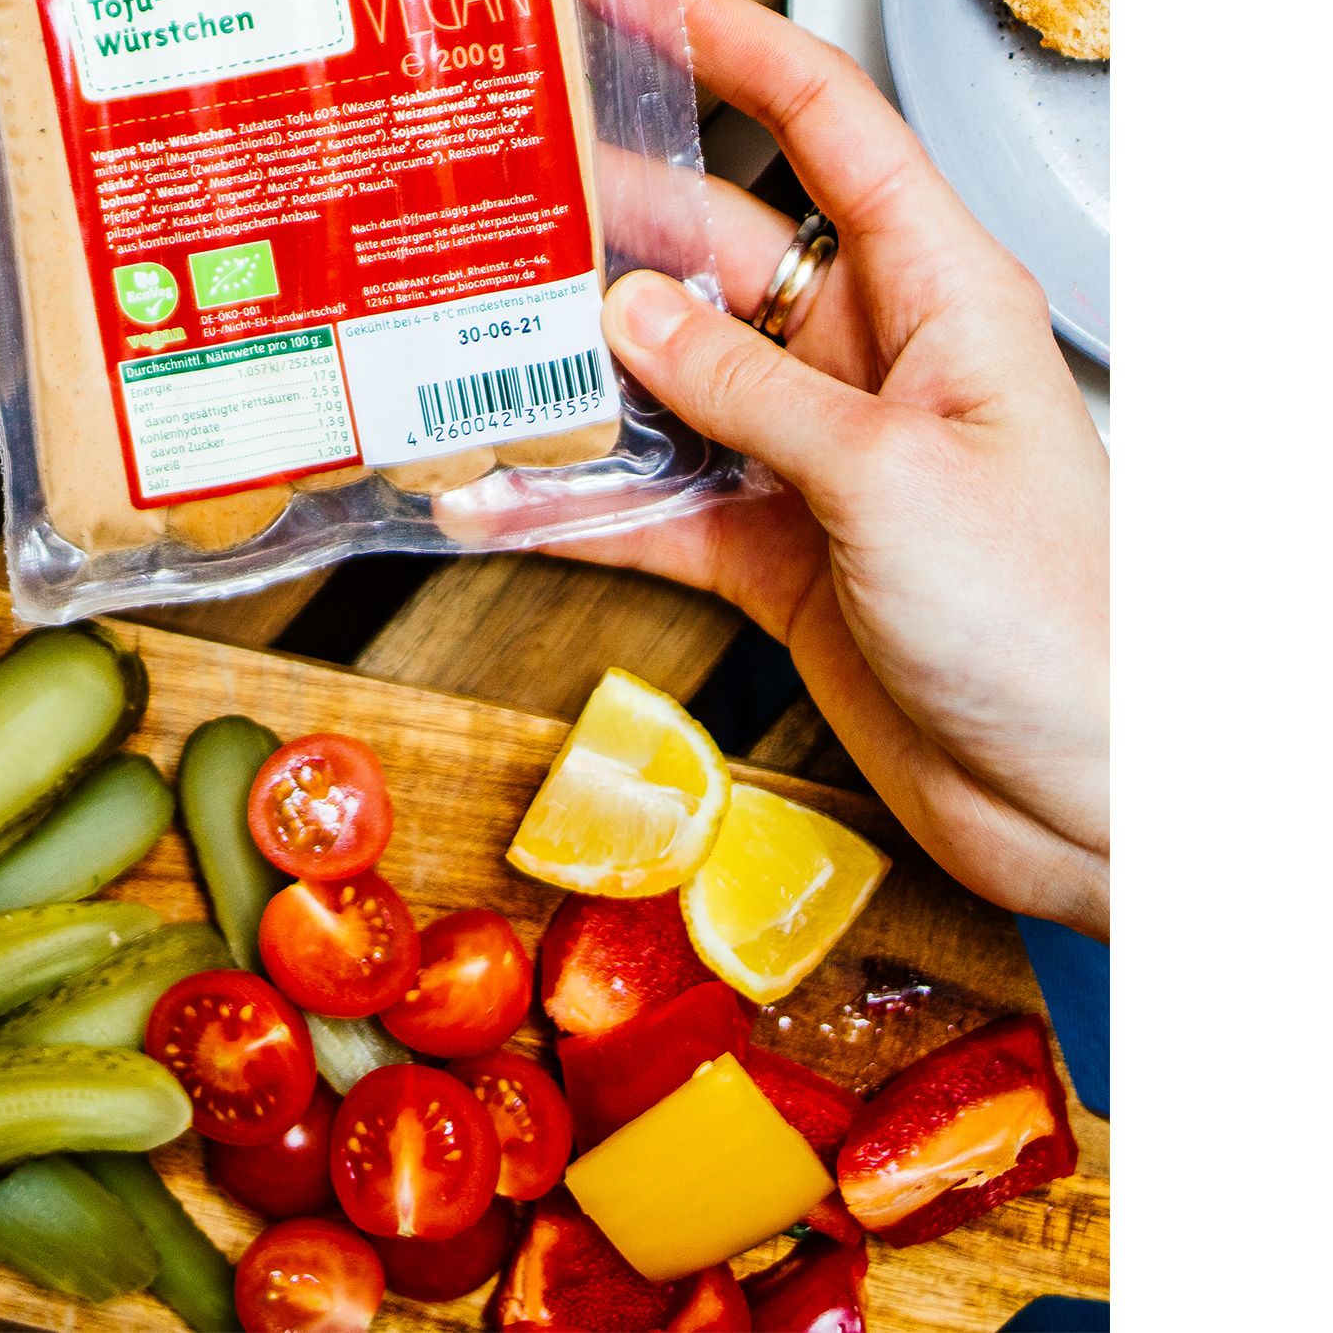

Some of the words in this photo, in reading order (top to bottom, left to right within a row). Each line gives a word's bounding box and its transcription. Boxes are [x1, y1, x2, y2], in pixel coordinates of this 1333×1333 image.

[94, 4, 253, 56] Würstchen
[91, 145, 136, 164] Vegane
[138, 126, 236, 156] Tofu-Würstchen.
[238, 116, 284, 134] Zutaten:
[287, 111, 313, 127] Tofu
[342, 97, 389, 116] (Wasser,
[473, 67, 544, 92] Gerinnungs-
[94, 162, 127, 177] mittel
[130, 155, 164, 173] Nigari
[487, 86, 535, 103] Weizen-
[145, 167, 188, 183] Gemüse
[391, 118, 451, 140] Sojasauce
[453, 108, 500, 128] (Wasser,
[502, 102, 533, 119] Soja-
[268, 158, 320, 178] Meersalz,
[416, 131, 465, 148] Gewürze
[510, 132, 544, 147] Stein-
[172, 210, 213, 226] Kräuter
[359, 176, 396, 191] Rauch.
[351, 221, 377, 233] Nach
[379, 217, 401, 228] dem
[403, 210, 437, 227] Öffnen
[440, 205, 468, 220] zügig
[470, 192, 537, 214] aufbrauchen.
[117, 243, 137, 253] aus
[138, 229, 201, 249] kontrolliert
[203, 215, 278, 240] biologischem
[279, 207, 320, 223] Anbau.
[355, 240, 378, 251] Bitte
[380, 230, 431, 249] entsorgen
[433, 226, 447, 236] Sie
[449, 221, 475, 233] diese
[477, 210, 538, 231] Verpackung
[540, 207, 550, 216] in
[552, 204, 568, 214] der
[358, 242, 434, 266] Wertstofftonne
[436, 239, 450, 252] für
[452, 219, 557, 249] Leichtverpackungen.
[126, 285, 173, 304] EcoVeg
[363, 285, 380, 295] BIO
[381, 276, 430, 292] COMPANY
[432, 269, 466, 284] GmbH,
[468, 261, 511, 276] Rheinstr.
[366, 295, 393, 307] 12161
[395, 289, 428, 303] Berlin,
[430, 269, 535, 298] www.biocompany.de
[200, 305, 260, 324] DE-ÖKO-001
[345, 319, 390, 337] Gekühlt
[393, 316, 410, 327] bei
[456, 294, 523, 315] mindestens
[526, 285, 568, 302] haltbar
[570, 281, 588, 293] bis:
[127, 326, 186, 353] vegan
[458, 315, 541, 344] 30-06-21
[125, 354, 203, 377] Durchschnittl.
[206, 343, 265, 362] Nährwerte
[268, 342, 287, 354] pro
[145, 412, 179, 427] davon
[182, 402, 239, 423] gesättigte
[406, 431, 416, 445] 4
[434, 412, 512, 440] 260042
[524, 391, 600, 423] 315555
[140, 421, 220, 447] Kohlenhydrate
[150, 443, 185, 457] davon
[187, 435, 224, 450] Zucker
[145, 459, 179, 474] Eiweiß
[148, 477, 169, 489] Salz
